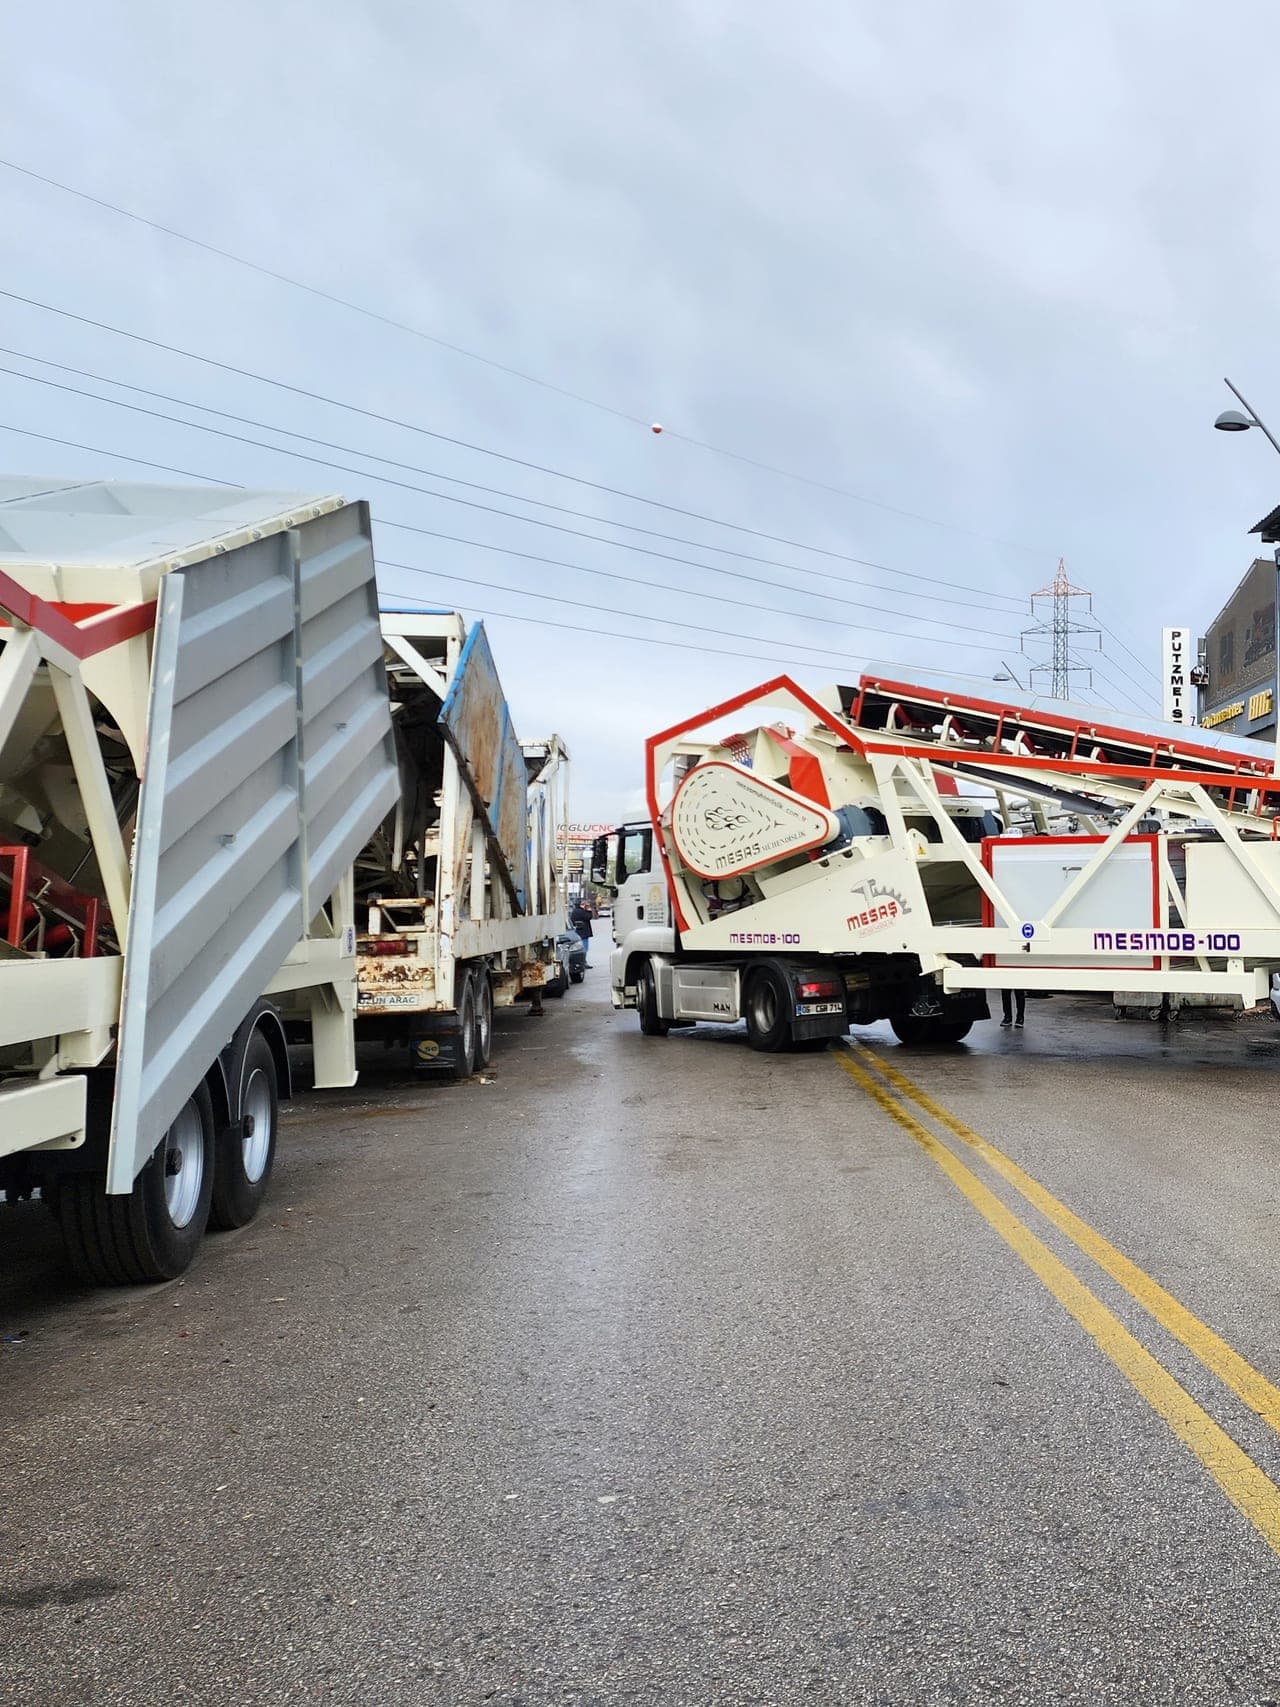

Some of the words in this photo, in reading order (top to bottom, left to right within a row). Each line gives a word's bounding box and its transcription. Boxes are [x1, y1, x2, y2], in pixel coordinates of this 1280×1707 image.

[1171, 631, 1184, 723] PUTZMEIS
[729, 933, 801, 944] MESMOB-100
[1093, 933, 1241, 950] MESMOB-100
[713, 1002, 731, 1012] MAN
